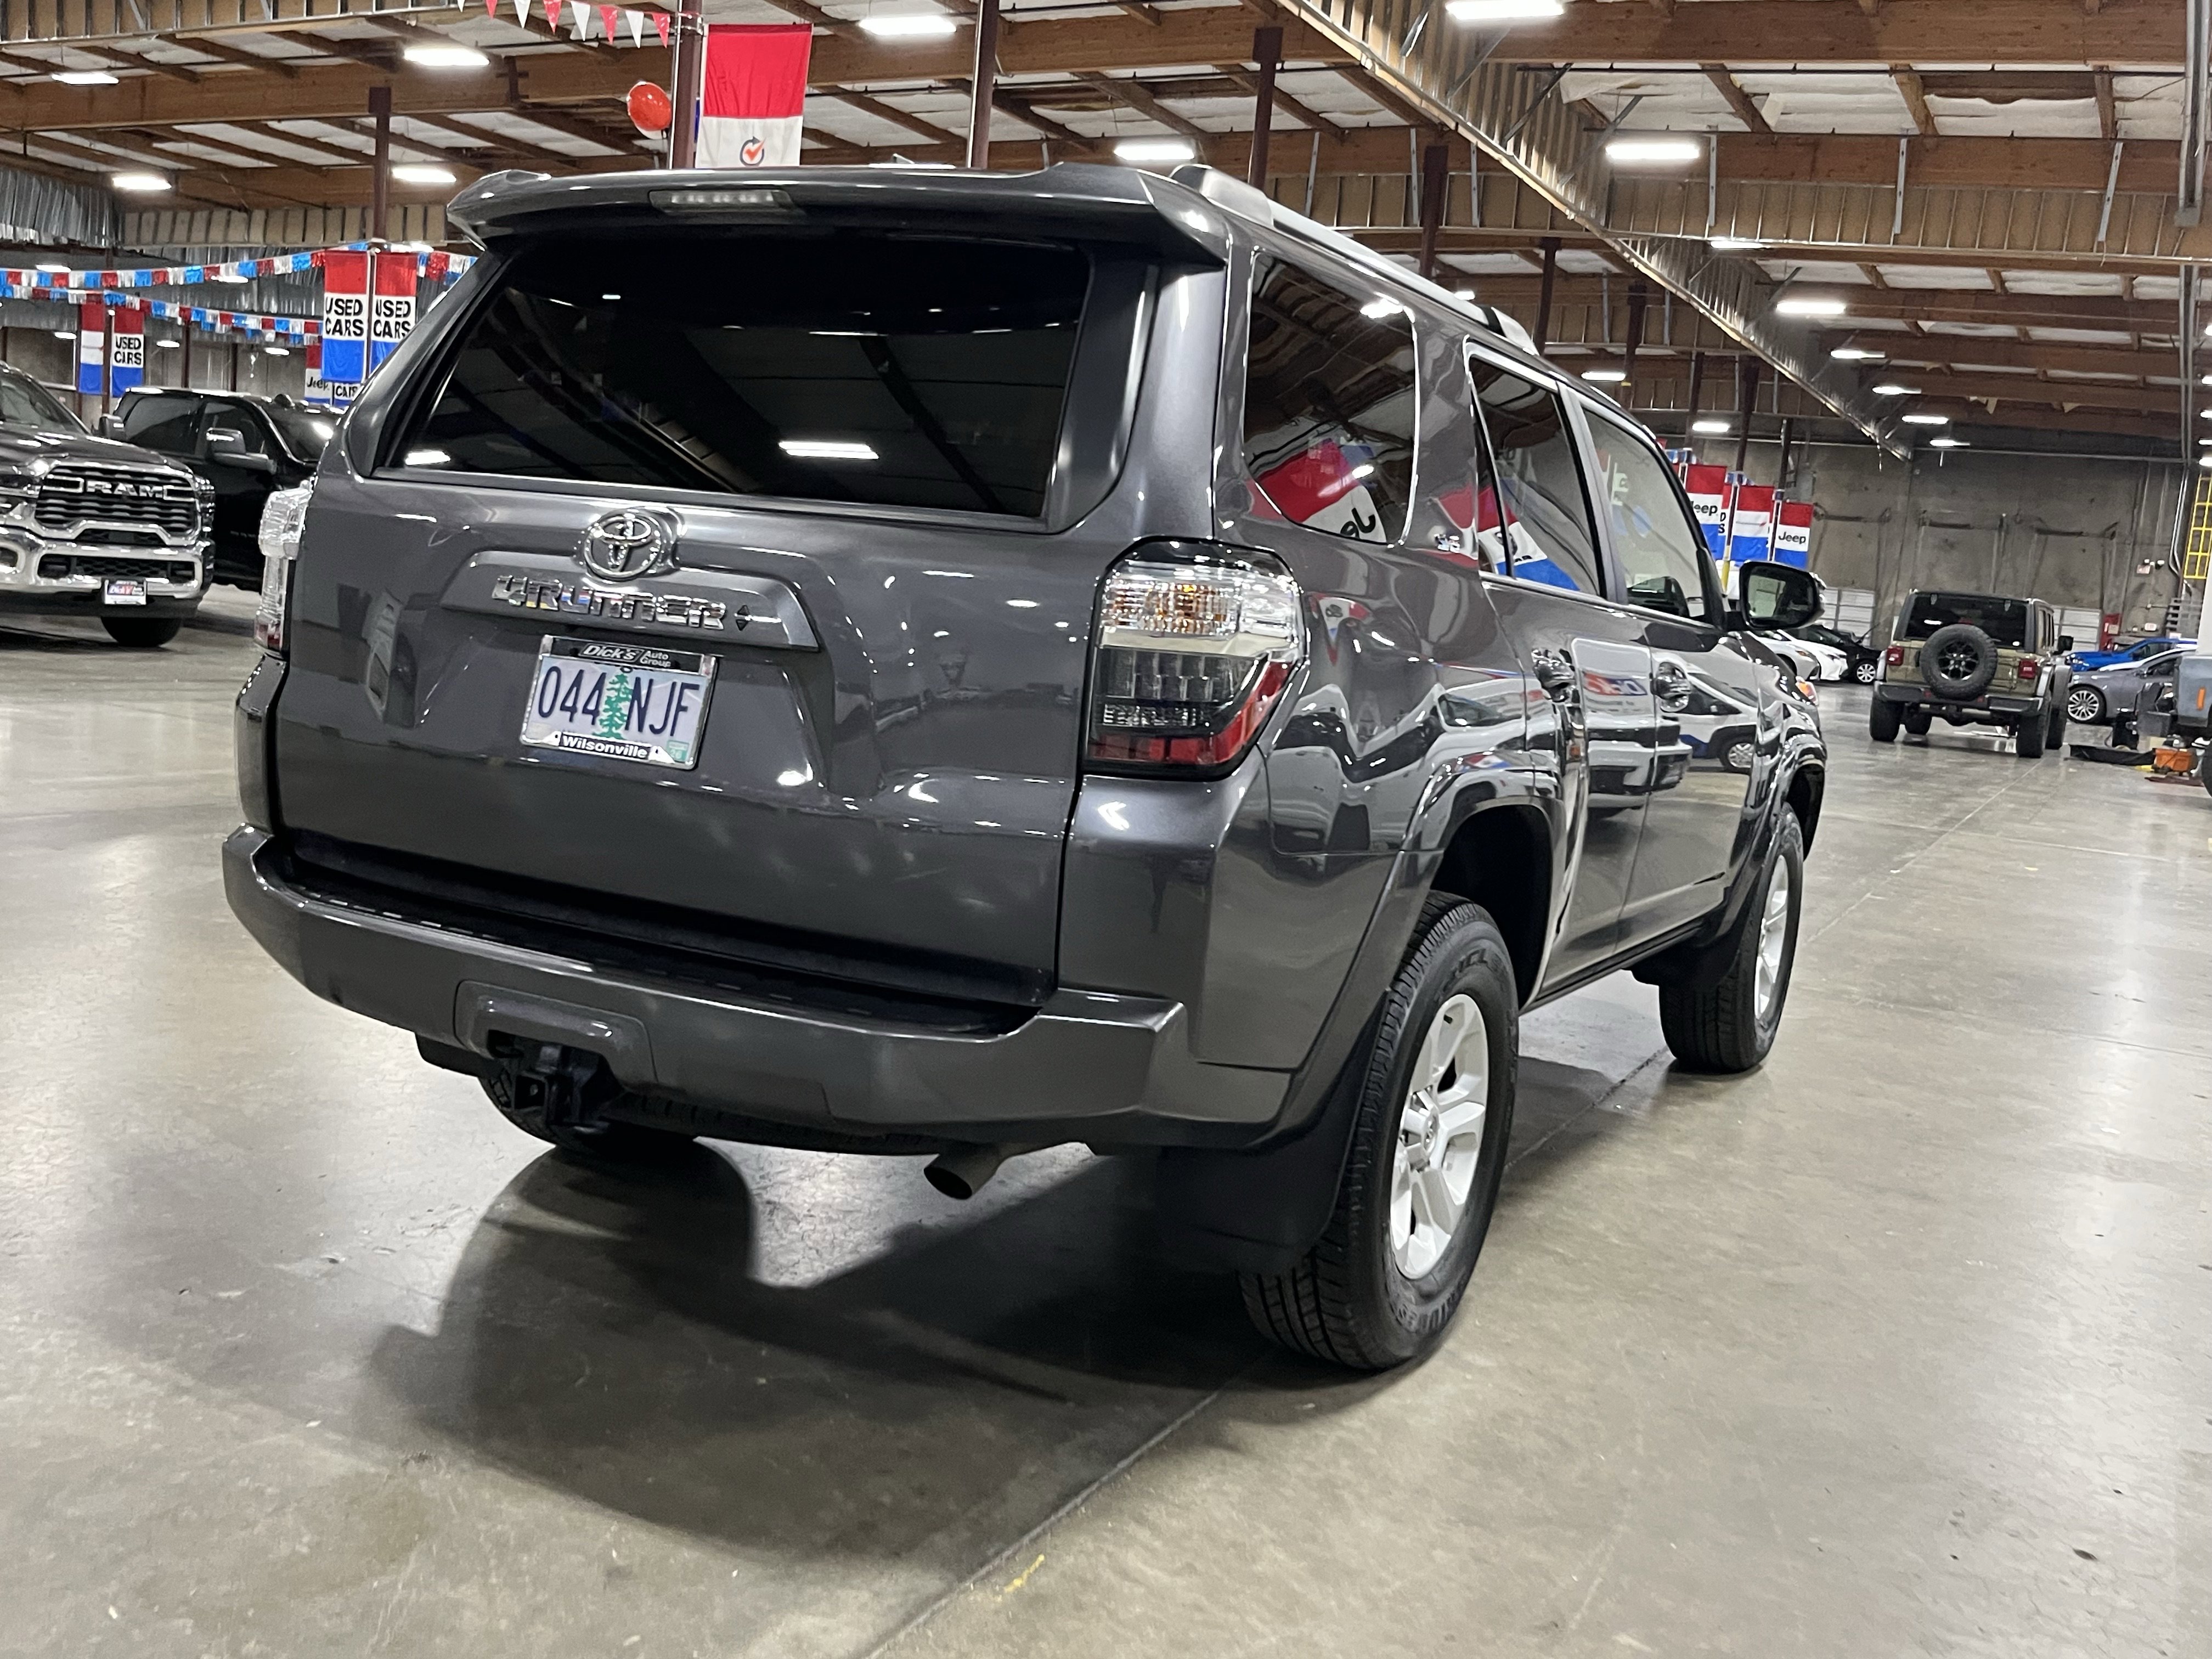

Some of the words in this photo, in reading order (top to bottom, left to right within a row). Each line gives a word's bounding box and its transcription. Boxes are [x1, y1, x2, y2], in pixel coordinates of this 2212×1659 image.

[325, 297, 363, 316] USED
[375, 299, 411, 318] USED
[325, 317, 364, 337] CARS
[373, 319, 411, 338] CARS
[115, 335, 142, 349] USED
[114, 351, 142, 365] CARS
[87, 480, 163, 498] RAM
[1778, 531, 1806, 544] Jeep
[492, 574, 725, 630] 4RUNNER
[583, 645, 637, 660] Dick's
[644, 650, 669, 660] Auto
[640, 656, 672, 668] Group
[538, 665, 607, 726] 044
[624, 676, 701, 736] NJF
[563, 735, 648, 759] Wilsonville
